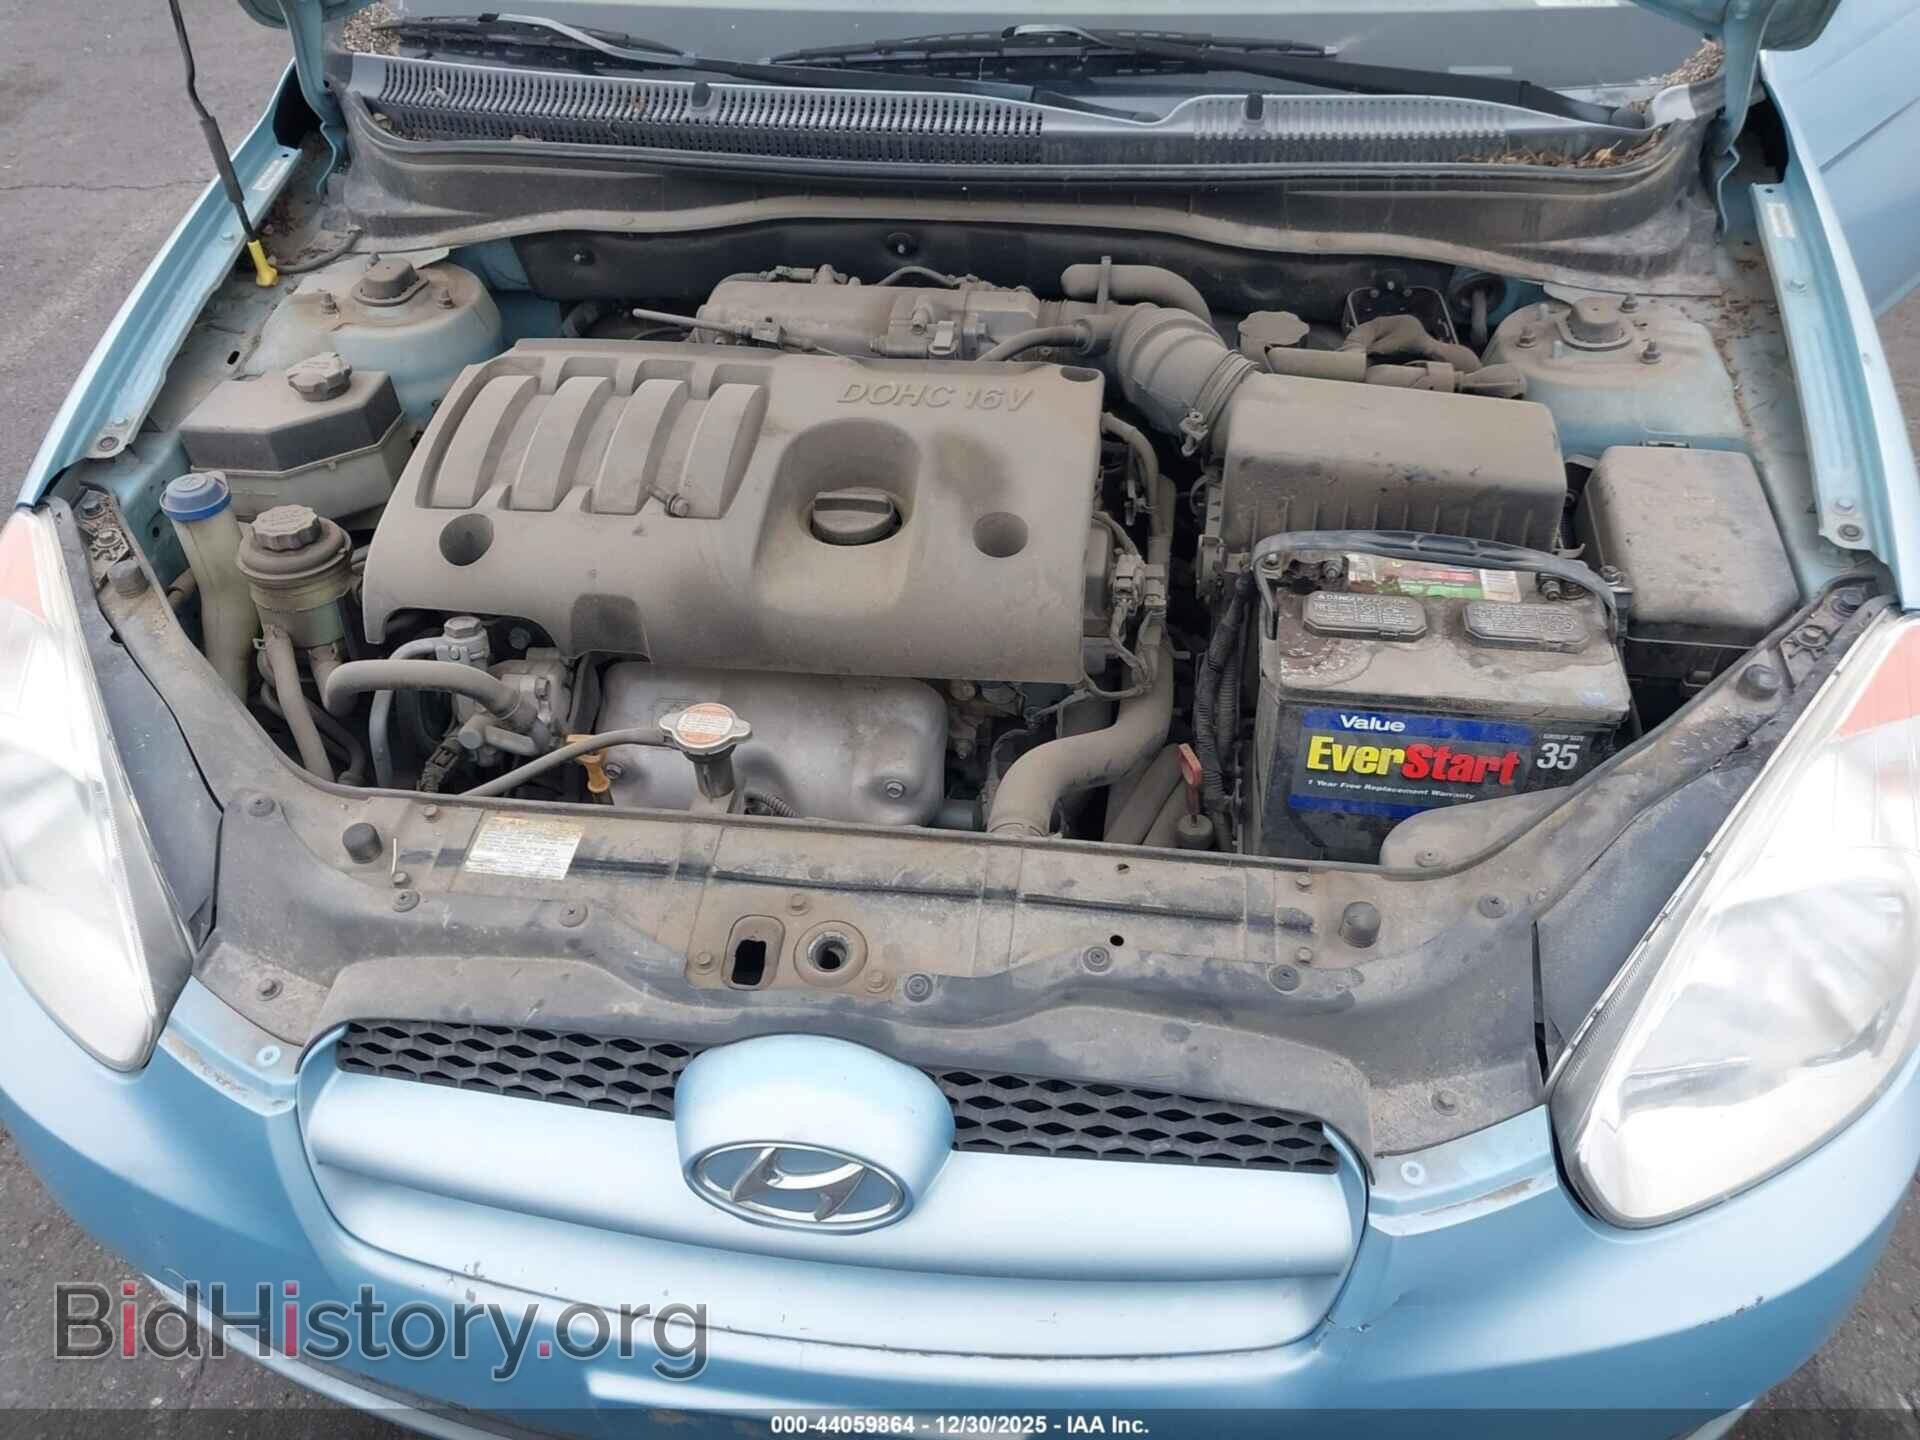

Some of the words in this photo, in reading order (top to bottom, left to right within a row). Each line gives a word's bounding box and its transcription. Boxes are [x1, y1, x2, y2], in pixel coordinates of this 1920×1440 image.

[836, 383, 956, 409] DOHC
[964, 387, 1035, 413] 16V
[1340, 714, 1406, 732] Value
[1306, 735, 1520, 785] EverStart
[1536, 742, 1580, 770] 35
[1316, 780, 1338, 788] Year
[1339, 781, 1363, 790] Free
[1363, 783, 1429, 796] Replacement
[1431, 788, 1476, 800] Warranty
